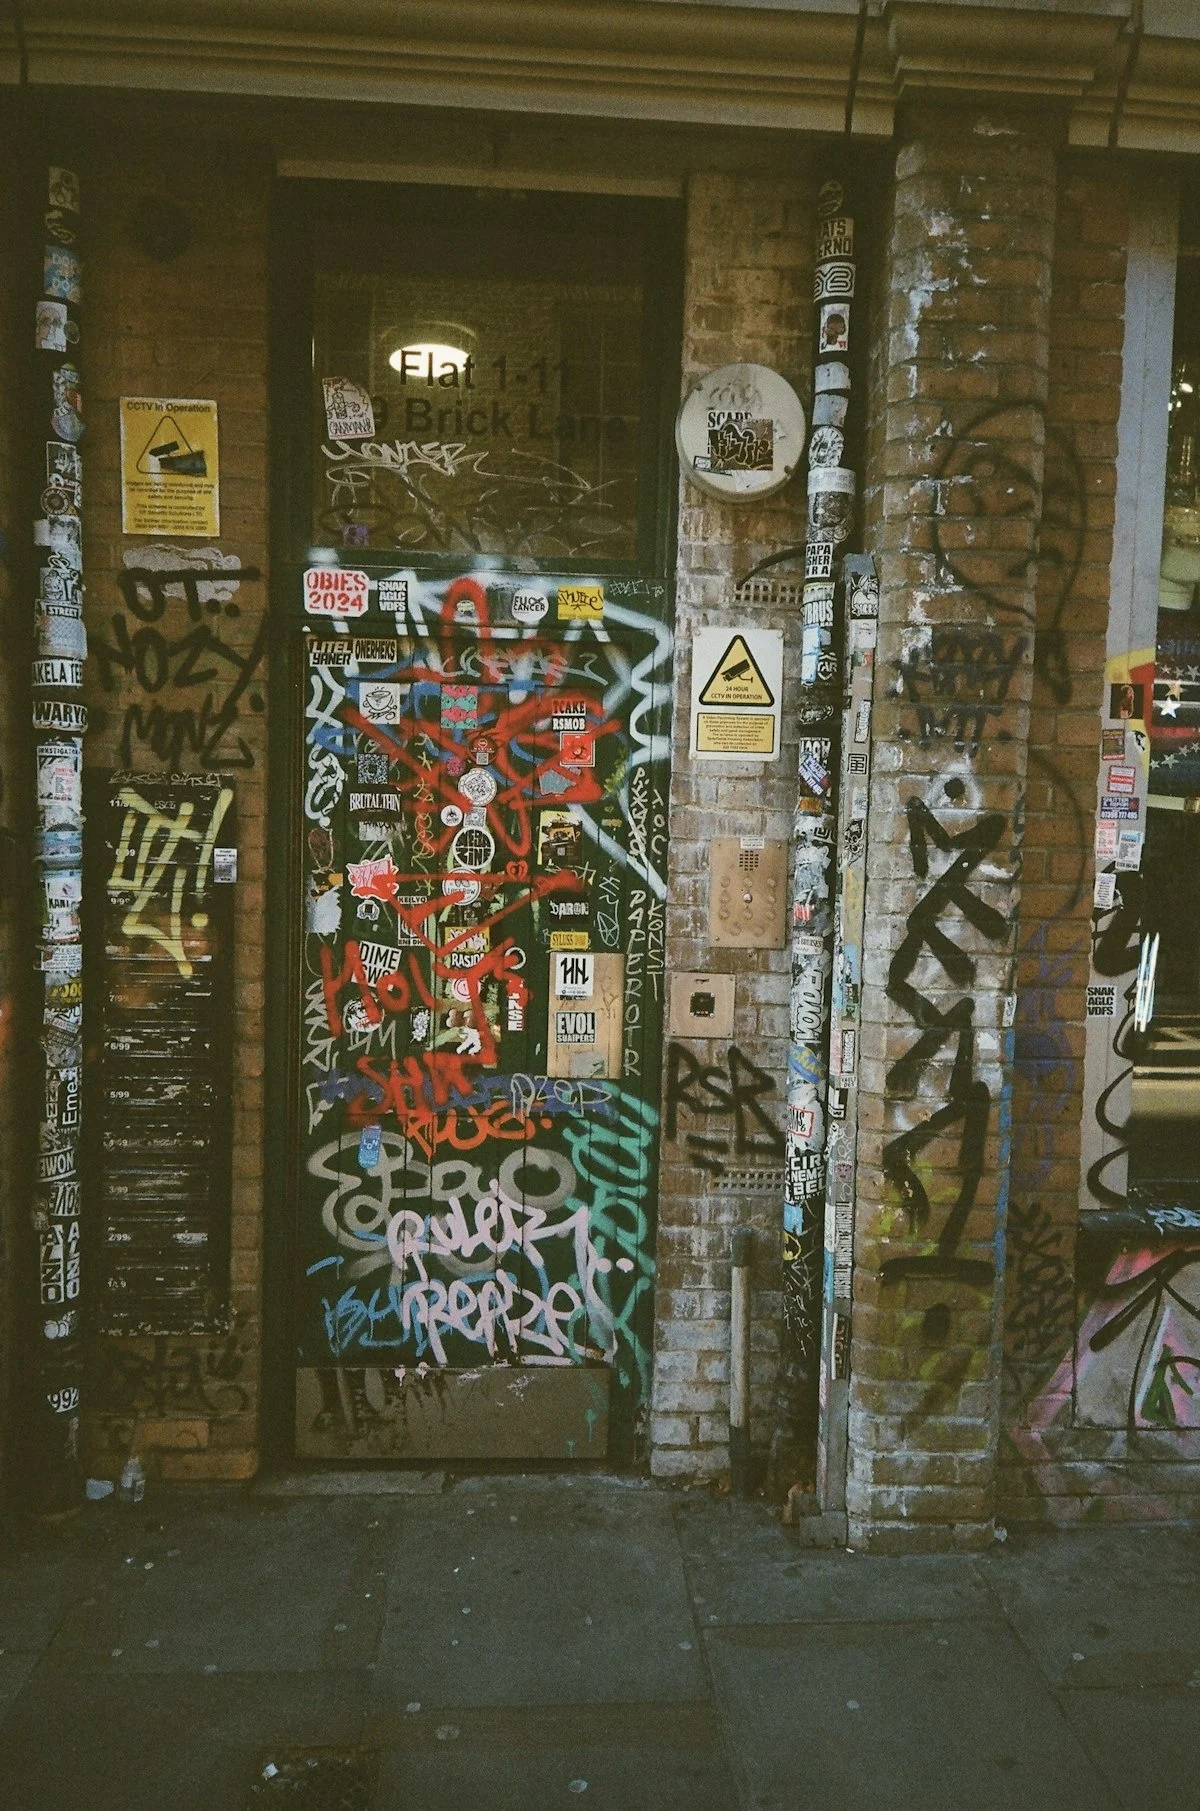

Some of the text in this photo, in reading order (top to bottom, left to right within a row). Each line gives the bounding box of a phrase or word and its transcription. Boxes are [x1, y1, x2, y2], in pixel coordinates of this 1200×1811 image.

[400, 350, 475, 388] Flat
[491, 355, 570, 395] 1-11
[126, 402, 153, 411] CCTV
[165, 403, 211, 413] Operation
[405, 397, 513, 438] Brick
[528, 403, 627, 442] Lane
[306, 572, 367, 592] OBIES
[378, 581, 407, 591] SNAK
[308, 591, 364, 612] 2024
[512, 603, 546, 612] CANCER
[48, 607, 78, 617] STREET
[311, 641, 353, 654] LITEL
[360, 943, 400, 970] DIME
[1087, 986, 1115, 996] SNAK
[1087, 1006, 1113, 1016] VDFS
[557, 1012, 595, 1034] EVOL
